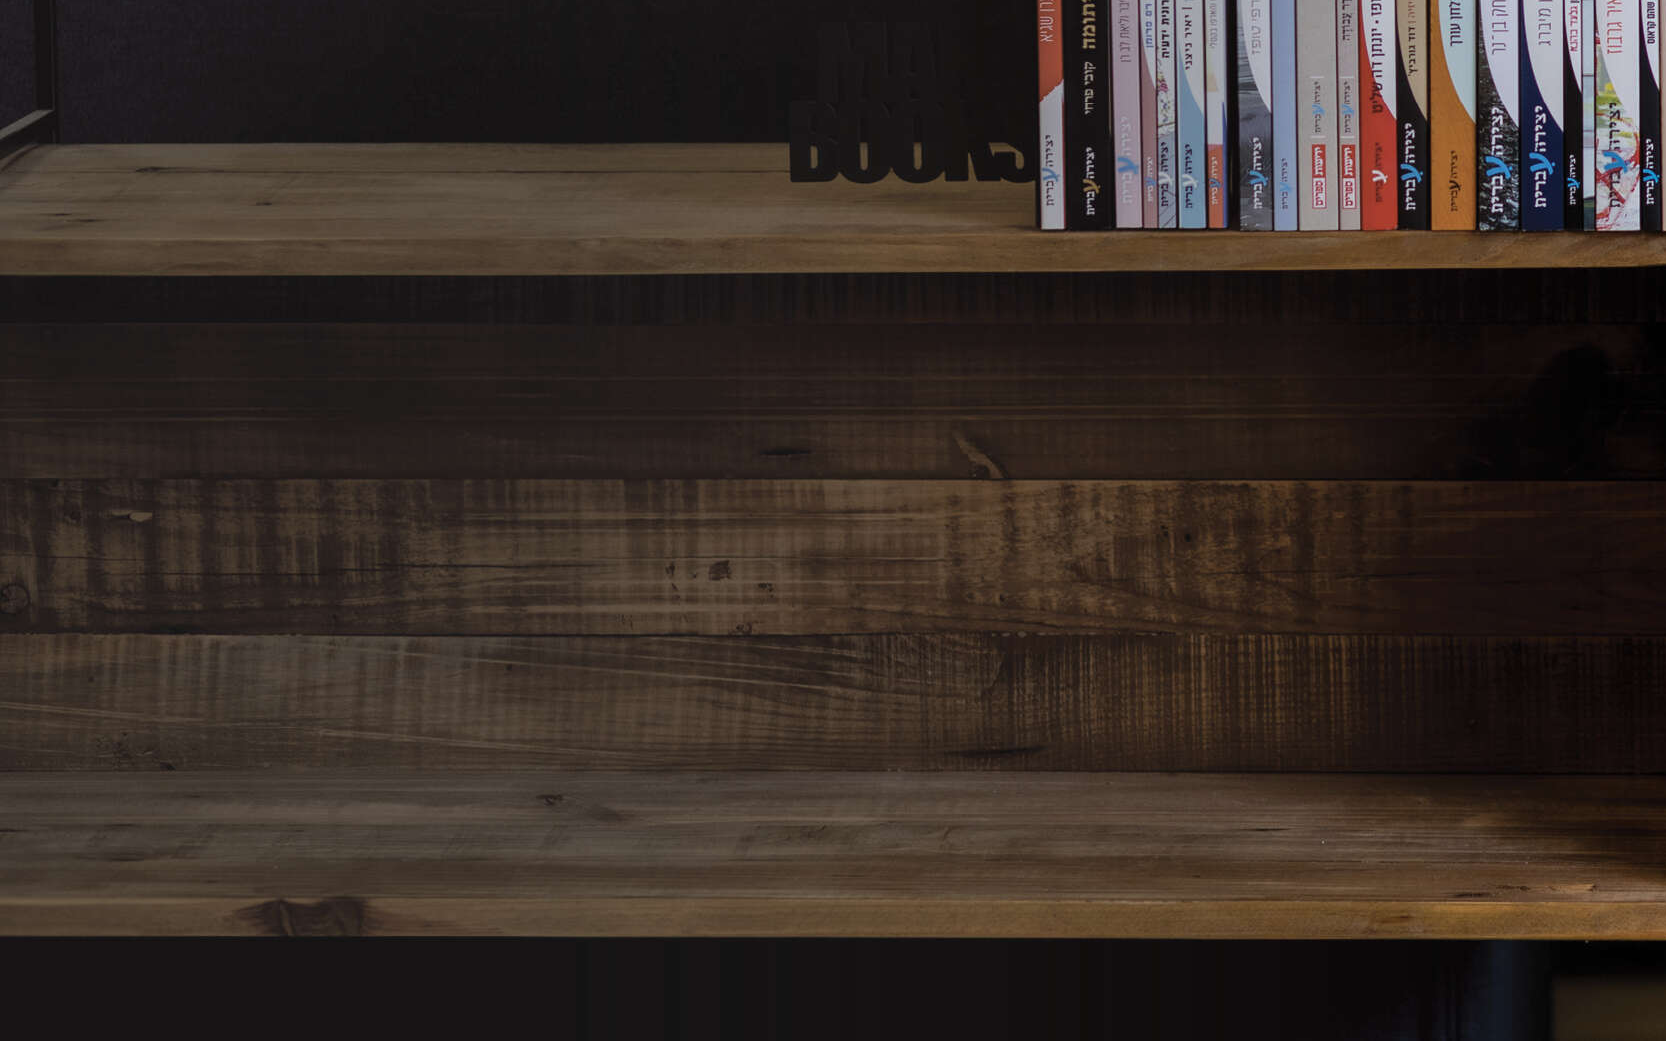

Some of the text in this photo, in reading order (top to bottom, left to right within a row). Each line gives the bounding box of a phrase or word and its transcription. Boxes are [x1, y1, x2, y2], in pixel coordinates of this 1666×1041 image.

[1145, 3, 1153, 17] רם
[1159, 0, 1170, 25] רונית
[1250, 0, 1261, 21] רפי
[1568, 5, 1578, 27] גלעד
[1646, 1, 1656, 19] שהם
[1039, 15, 1054, 43] שגיא
[1145, 21, 1155, 48] פרומן
[1184, 14, 1193, 38] יאיר
[1408, 26, 1416, 42] דוד
[1449, 23, 1464, 47] עורך
[1537, 8, 1552, 46] מיברג
[1607, 22, 1624, 55] גרבוז
[1647, 21, 1657, 45] קראוס
[1159, 29, 1171, 59] ידעיה
[1250, 25, 1262, 55] טופז
[1371, 27, 1385, 58] יונתן
[1084, 61, 1096, 86] קובי
[1371, 60, 1383, 78] דה
[1083, 89, 1095, 115] פרחי
[1369, 81, 1384, 114] שליט
